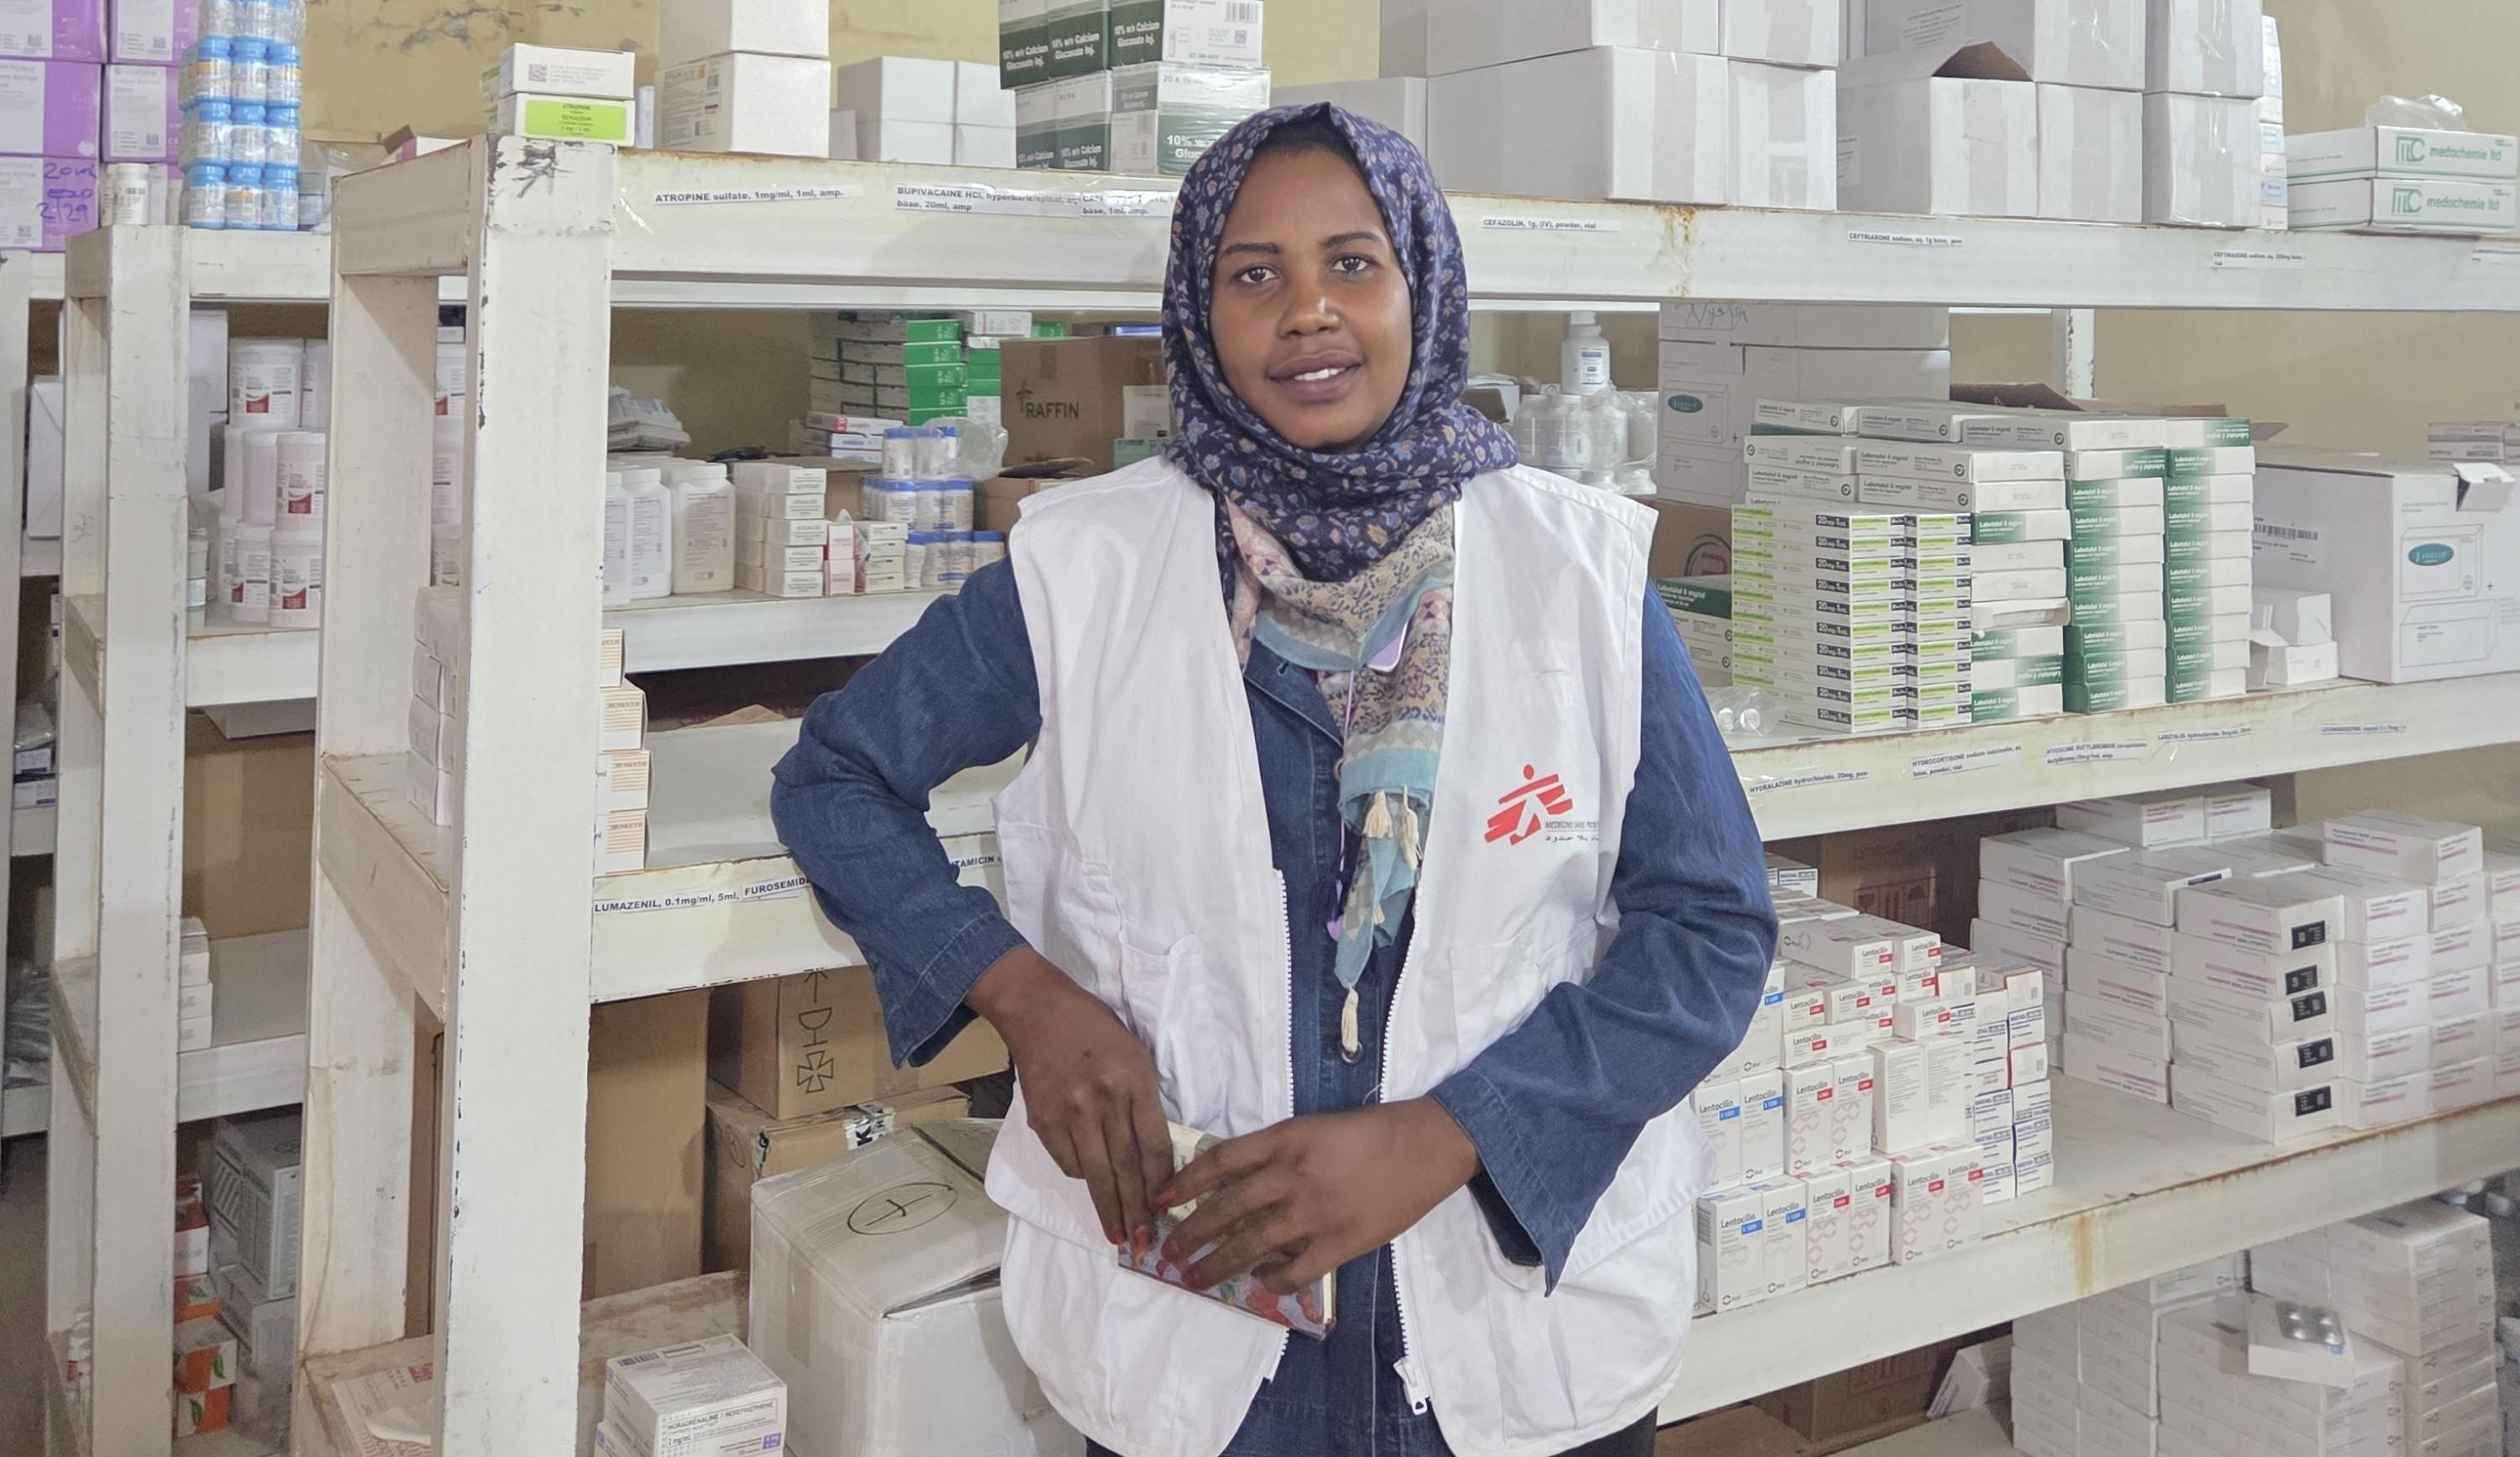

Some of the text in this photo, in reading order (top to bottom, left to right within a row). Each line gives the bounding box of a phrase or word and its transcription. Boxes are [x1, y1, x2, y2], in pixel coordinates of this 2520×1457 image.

[2430, 146, 2487, 160] medochemie
[655, 192, 710, 202] ATROPINE
[713, 191, 751, 202] sulfate,
[755, 191, 793, 201] 1mg/ml,
[819, 190, 843, 199] amp.
[897, 186, 963, 198] BUPIVACAINE
[897, 200, 922, 209] base,
[2427, 197, 2485, 210] medochemie
[1483, 219, 1525, 228] CEFAZOLIN,
[1749, 778, 1793, 794] HYDRALAZINE
[953, 855, 995, 867] TAMICIN
[744, 878, 809, 896] FUROSEMID
[594, 892, 740, 912] LUMAZENIL, 0.1mg/ml, 5ml,
[1699, 1099, 1734, 1114] Lentocilin
[1721, 1212, 1756, 1229] Lentocilin
